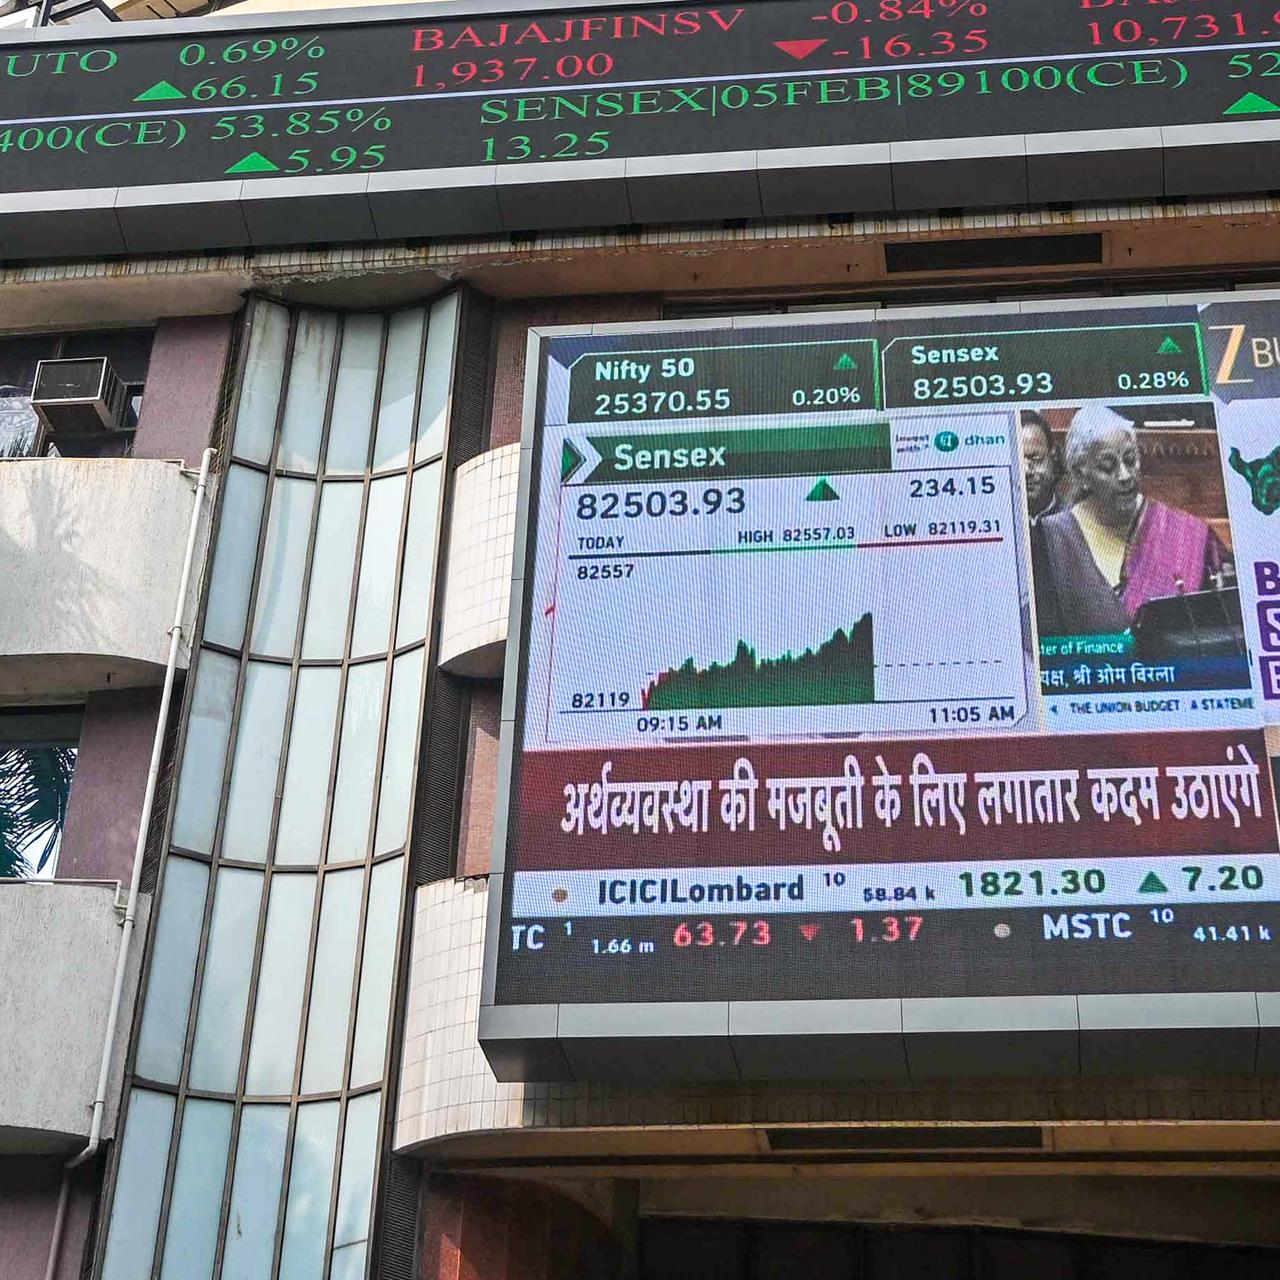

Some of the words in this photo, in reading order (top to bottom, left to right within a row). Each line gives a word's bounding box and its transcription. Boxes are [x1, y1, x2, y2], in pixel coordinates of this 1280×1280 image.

[412, 8, 745, 52] BAJAJFINSV
[179, 36, 325, 68] 0.69%
[413, 53, 614, 89] 1,937.00
[832, 29, 990, 60] -16.35
[192, 72, 320, 101] 66.15
[210, 107, 392, 142] 53.85%
[283, 145, 387, 174] 5.95
[481, 131, 611, 163] 13.25
[911, 345, 999, 365] Sensex
[595, 360, 651, 383] Nifty
[661, 358, 695, 378] 50
[914, 372, 1053, 400] 82503.93
[1118, 371, 1189, 390] 0.28%
[595, 388, 731, 416] 25370.55
[793, 387, 861, 405] 0.20%
[965, 435, 1005, 446] dhan
[614, 444, 727, 471] Sensex
[576, 487, 746, 520] 82503.93
[910, 476, 995, 498] 234.15
[578, 536, 624, 550] TODAY
[738, 530, 772, 543] HIGH
[783, 526, 855, 542] 82557.03
[885, 524, 916, 538] LOW
[929, 520, 1000, 535] 82119.31
[578, 564, 634, 580] 82557
[1076, 641, 1124, 654] Finance
[1074, 665, 1091, 685] श्री
[1097, 663, 1126, 684] ओम
[571, 692, 630, 708] 82119
[930, 707, 980, 723] 11:05
[989, 705, 1015, 721] AM
[1070, 702, 1092, 714] THE
[1135, 700, 1180, 712] BUDGET
[637, 717, 689, 732] 09:15
[695, 715, 722, 730] AM
[561, 761, 712, 835] अर्थव्यवस्था
[719, 758, 758, 832] की
[766, 755, 864, 852] मजबूती
[872, 756, 901, 827] के
[909, 752, 967, 835] लिए
[975, 769, 1080, 825] लगातार
[1087, 767, 1160, 825] कदम
[1166, 744, 1262, 828] उठाएंगे
[599, 875, 804, 905] ICICILombard
[823, 872, 846, 887] 10
[926, 885, 935, 900] k
[959, 868, 1106, 897] 1821.30
[1182, 865, 1263, 892] 7.20
[592, 939, 632, 954] 1.66
[639, 941, 654, 953] m
[673, 920, 771, 947] 63.73
[850, 916, 923, 942] 1.37
[1043, 913, 1132, 941] MSTC
[1150, 908, 1174, 924] 10
[1192, 926, 1250, 942] 41.41
[1259, 924, 1271, 941] k
